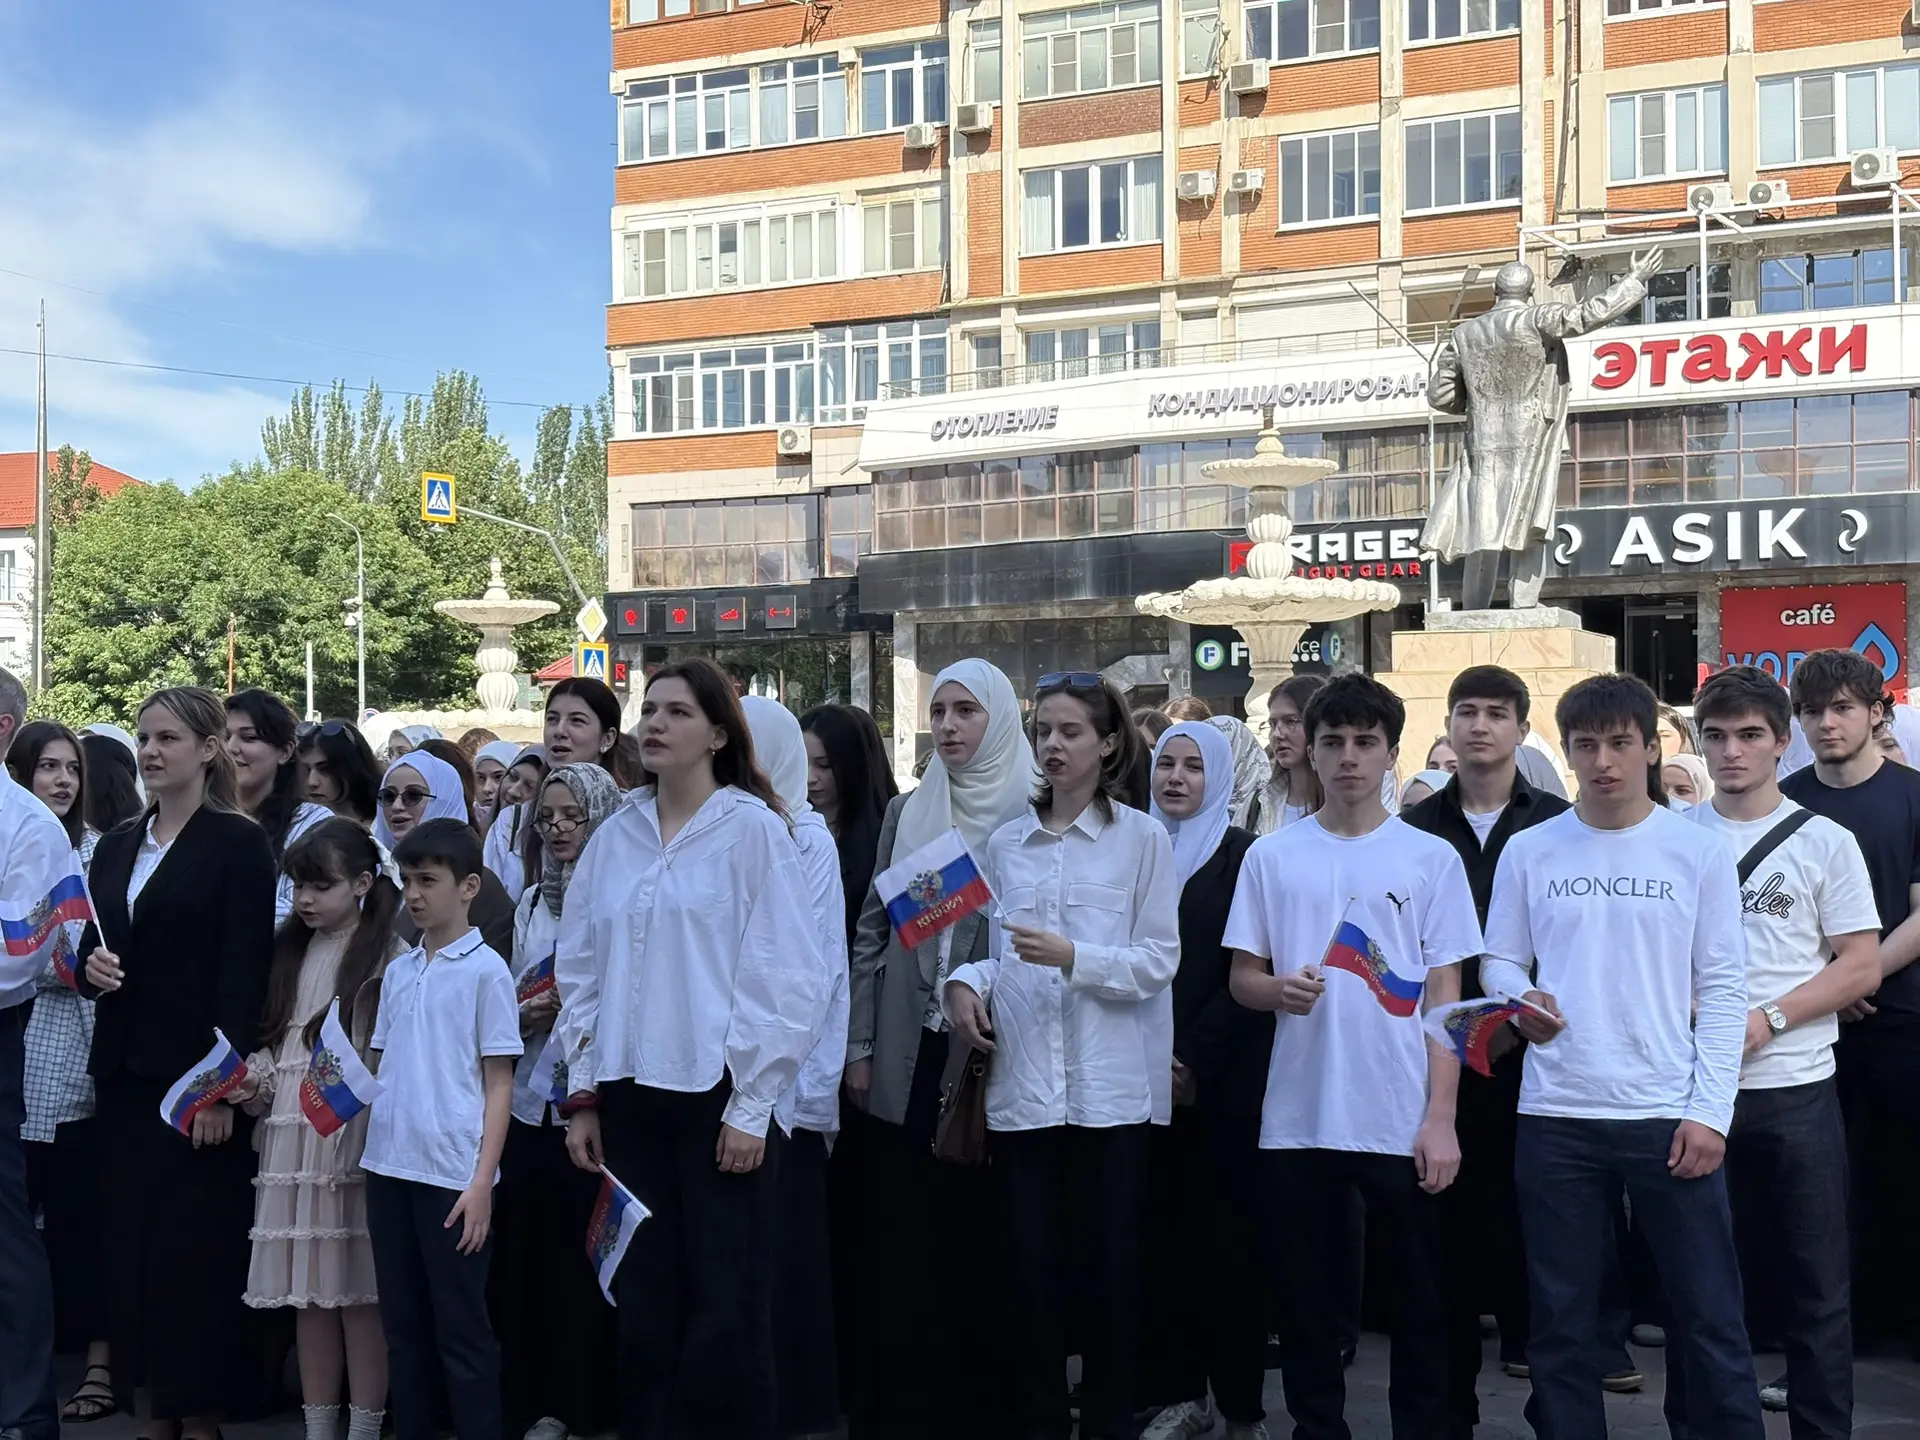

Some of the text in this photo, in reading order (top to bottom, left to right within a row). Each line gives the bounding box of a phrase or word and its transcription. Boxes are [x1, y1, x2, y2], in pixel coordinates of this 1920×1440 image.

[1148, 373, 1429, 418] КОНДИЦИОНИРОВАН
[931, 404, 1059, 441] ОТОПЛЕНИЕ
[1284, 529, 1419, 563] RAGE
[1610, 508, 1807, 567] ASIK
[1290, 561, 1422, 579] IGHT GEAR
[1780, 603, 1836, 626] café
[1547, 876, 1676, 901] MONCLER
[1740, 872, 1794, 919] cler
